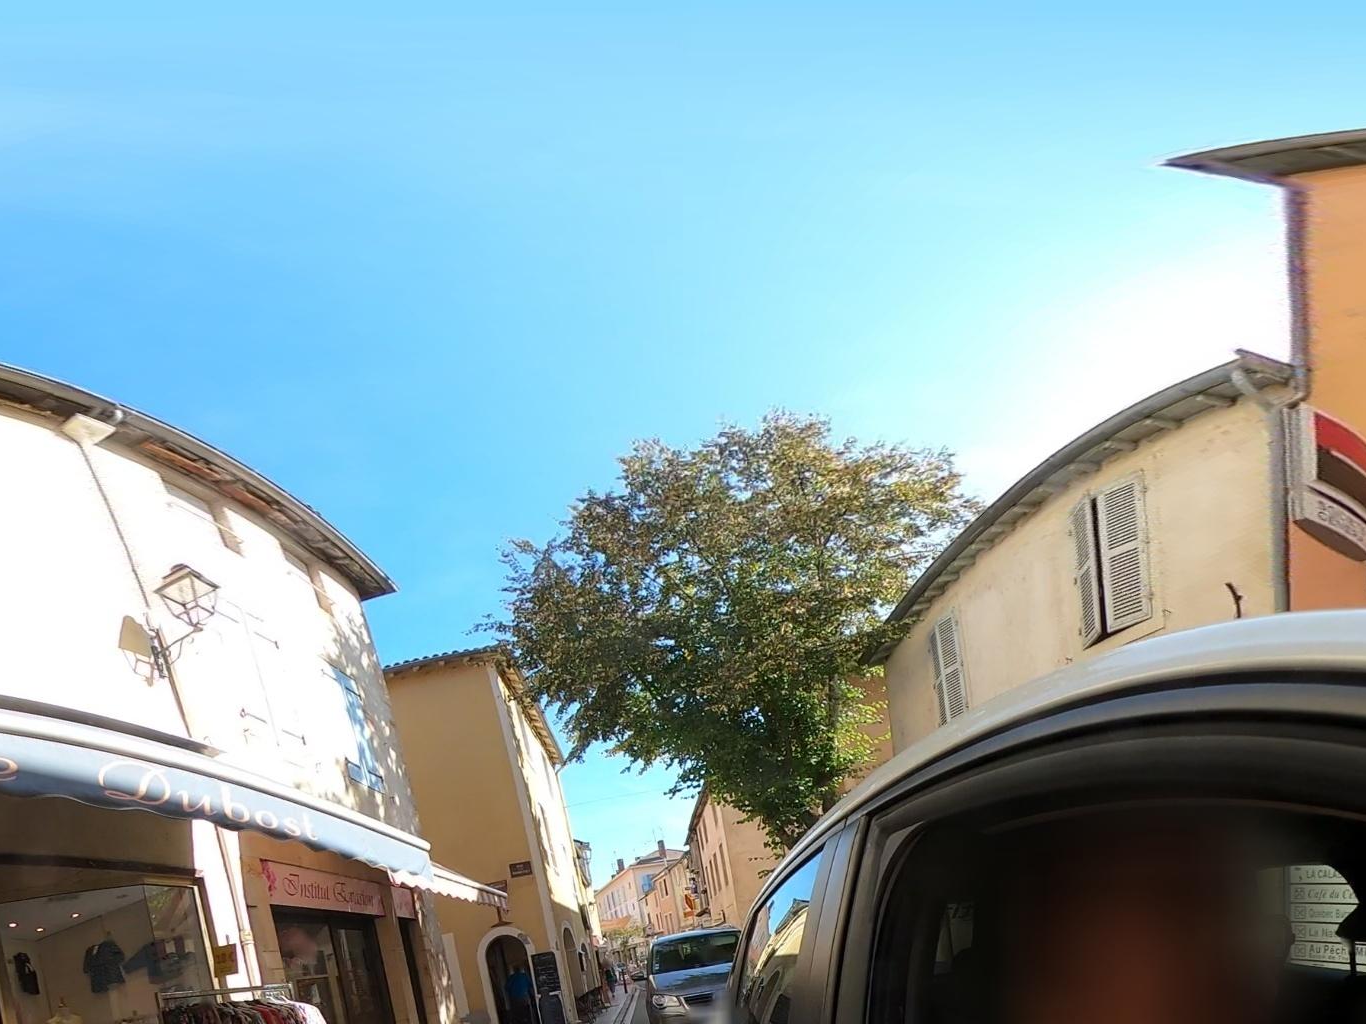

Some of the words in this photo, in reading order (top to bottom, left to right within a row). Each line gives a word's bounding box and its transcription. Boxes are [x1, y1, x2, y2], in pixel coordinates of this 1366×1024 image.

[96, 759, 318, 843] Dubost
[282, 873, 330, 900] Institut
[1329, 888, 1340, 899] du
[1308, 944, 1321, 953] Au
[1323, 944, 1347, 955] Péch
